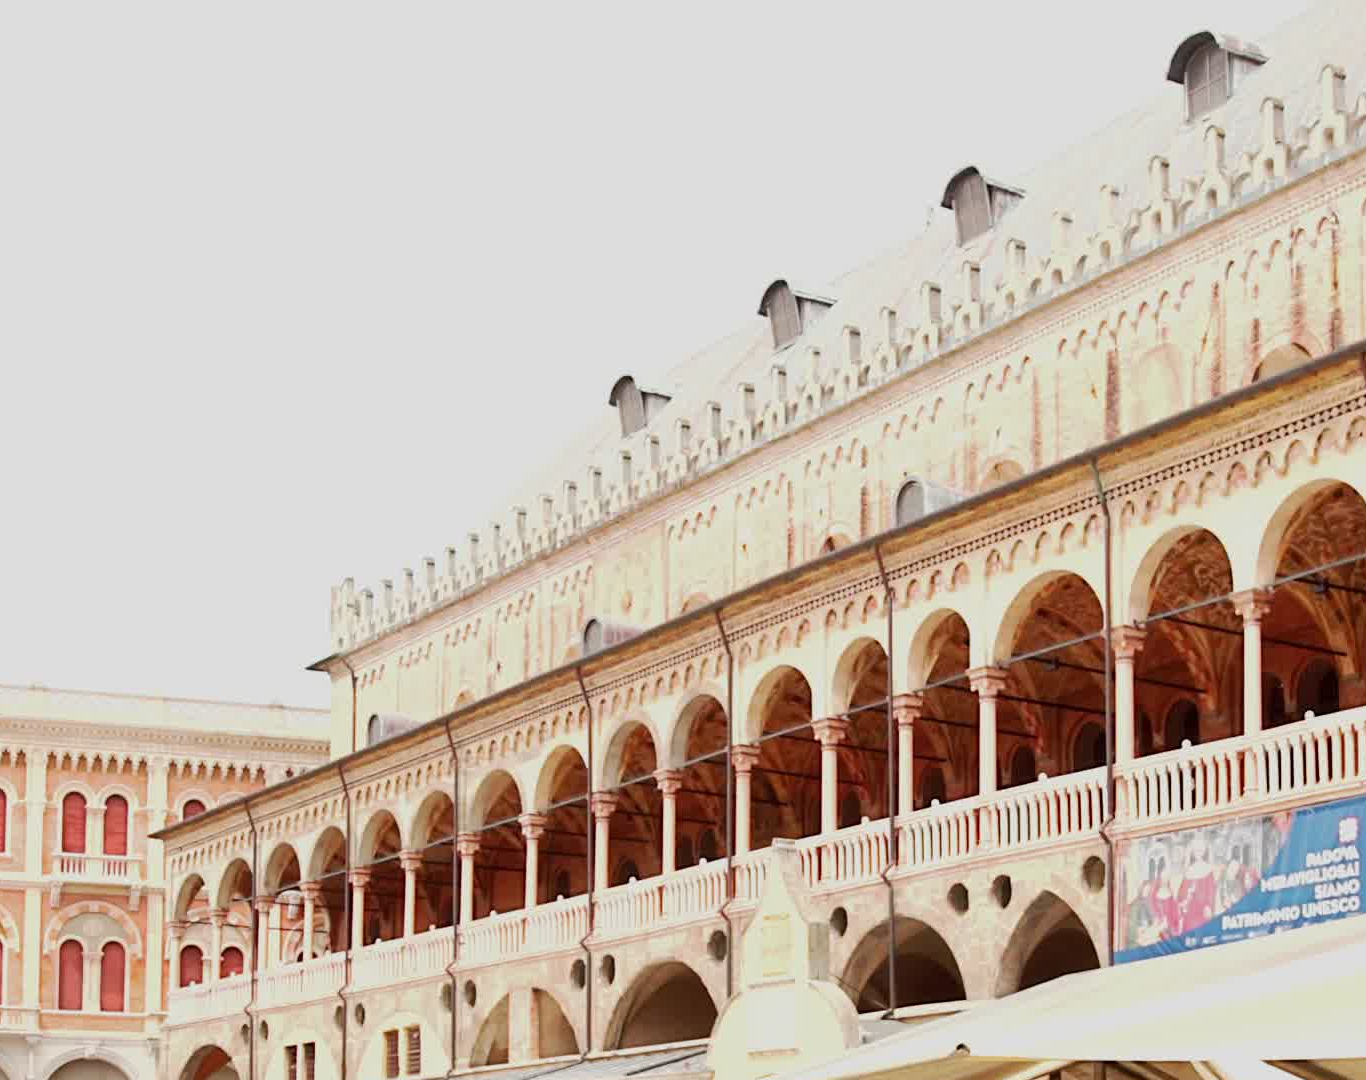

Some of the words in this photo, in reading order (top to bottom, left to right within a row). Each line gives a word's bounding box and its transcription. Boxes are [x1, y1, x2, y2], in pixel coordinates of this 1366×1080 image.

[1306, 846, 1359, 867] PADOVA
[1314, 879, 1361, 900] SIAMO
[1222, 905, 1301, 930] PATRIMONIO
[1302, 895, 1361, 917] UNESCO
